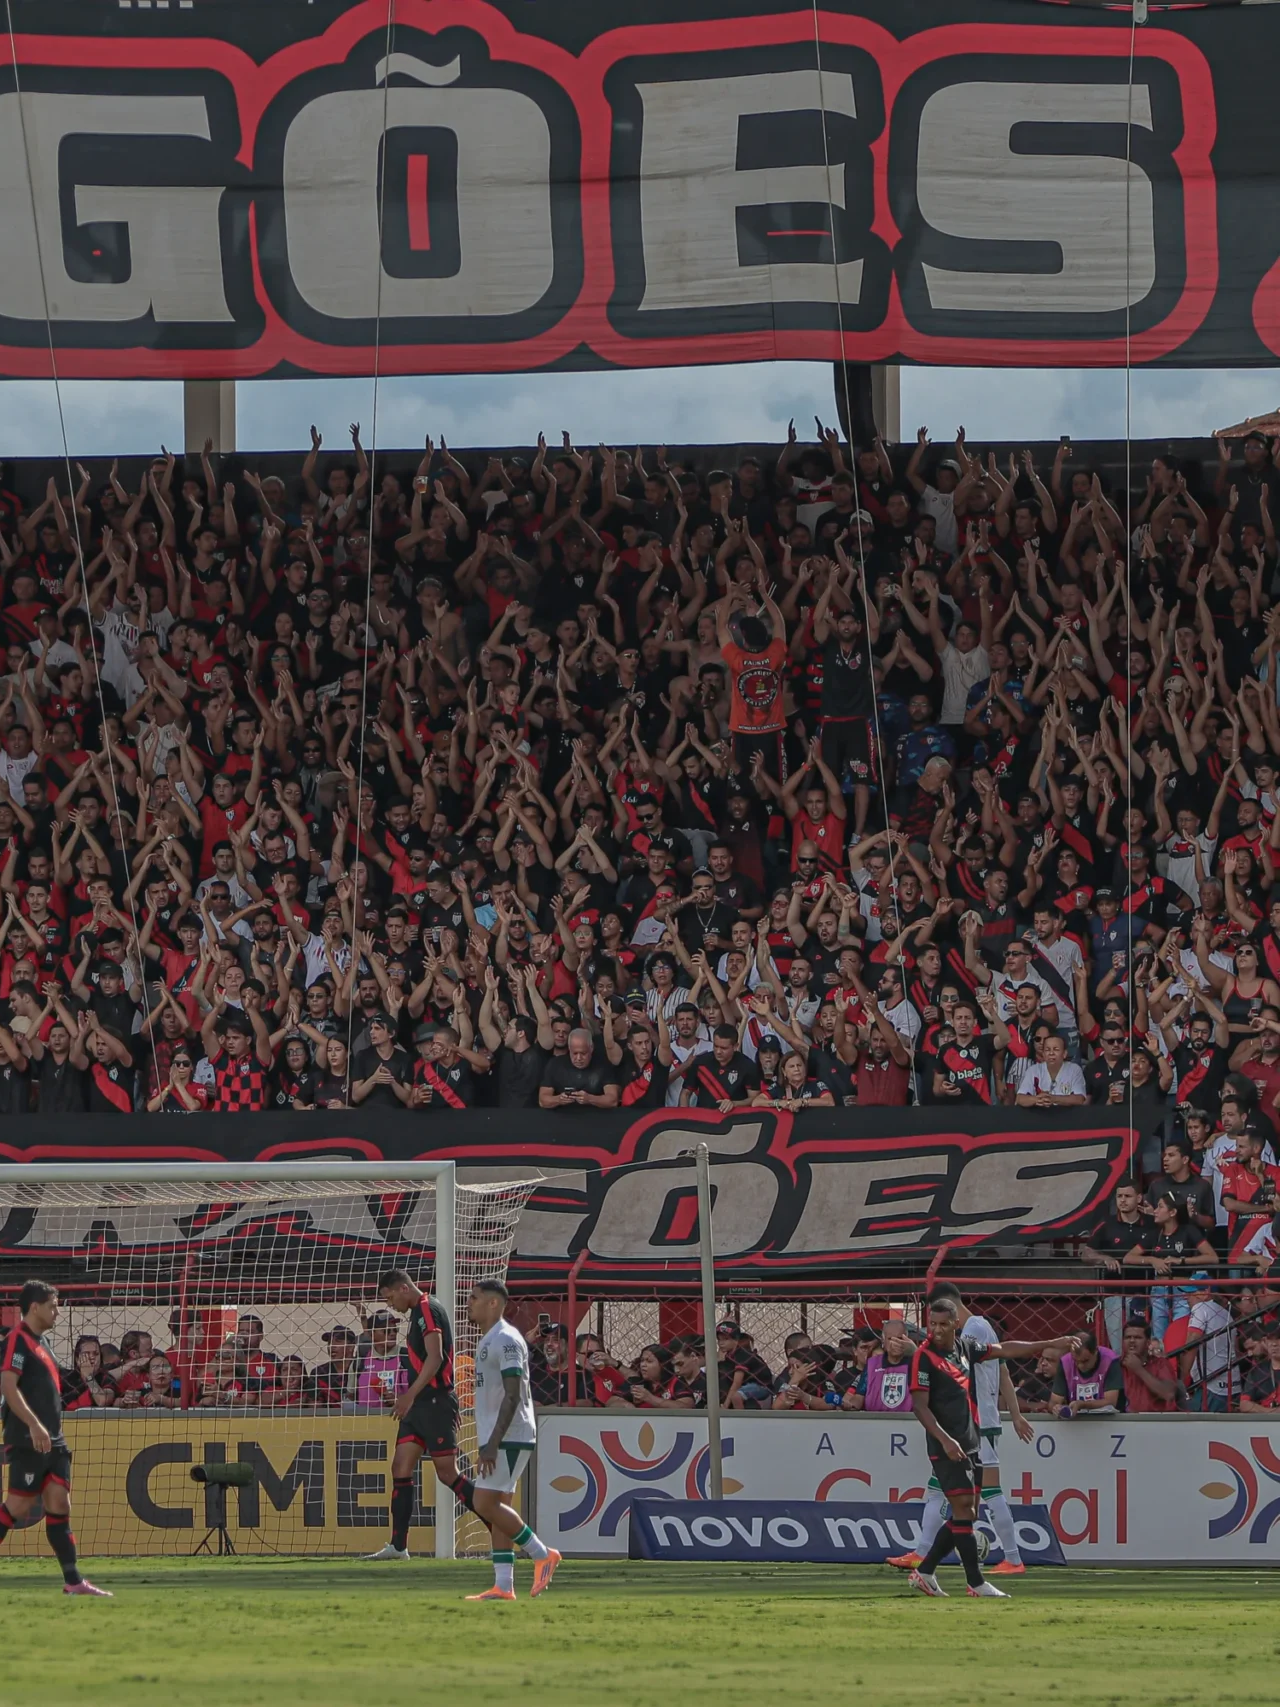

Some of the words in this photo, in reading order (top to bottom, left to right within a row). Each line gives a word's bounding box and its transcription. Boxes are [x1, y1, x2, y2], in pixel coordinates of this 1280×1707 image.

[957, 1066, 983, 1079] blaze
[815, 1433, 1128, 1459] AROZ
[649, 1514, 810, 1549] novo
[823, 1517, 1052, 1553] muo
